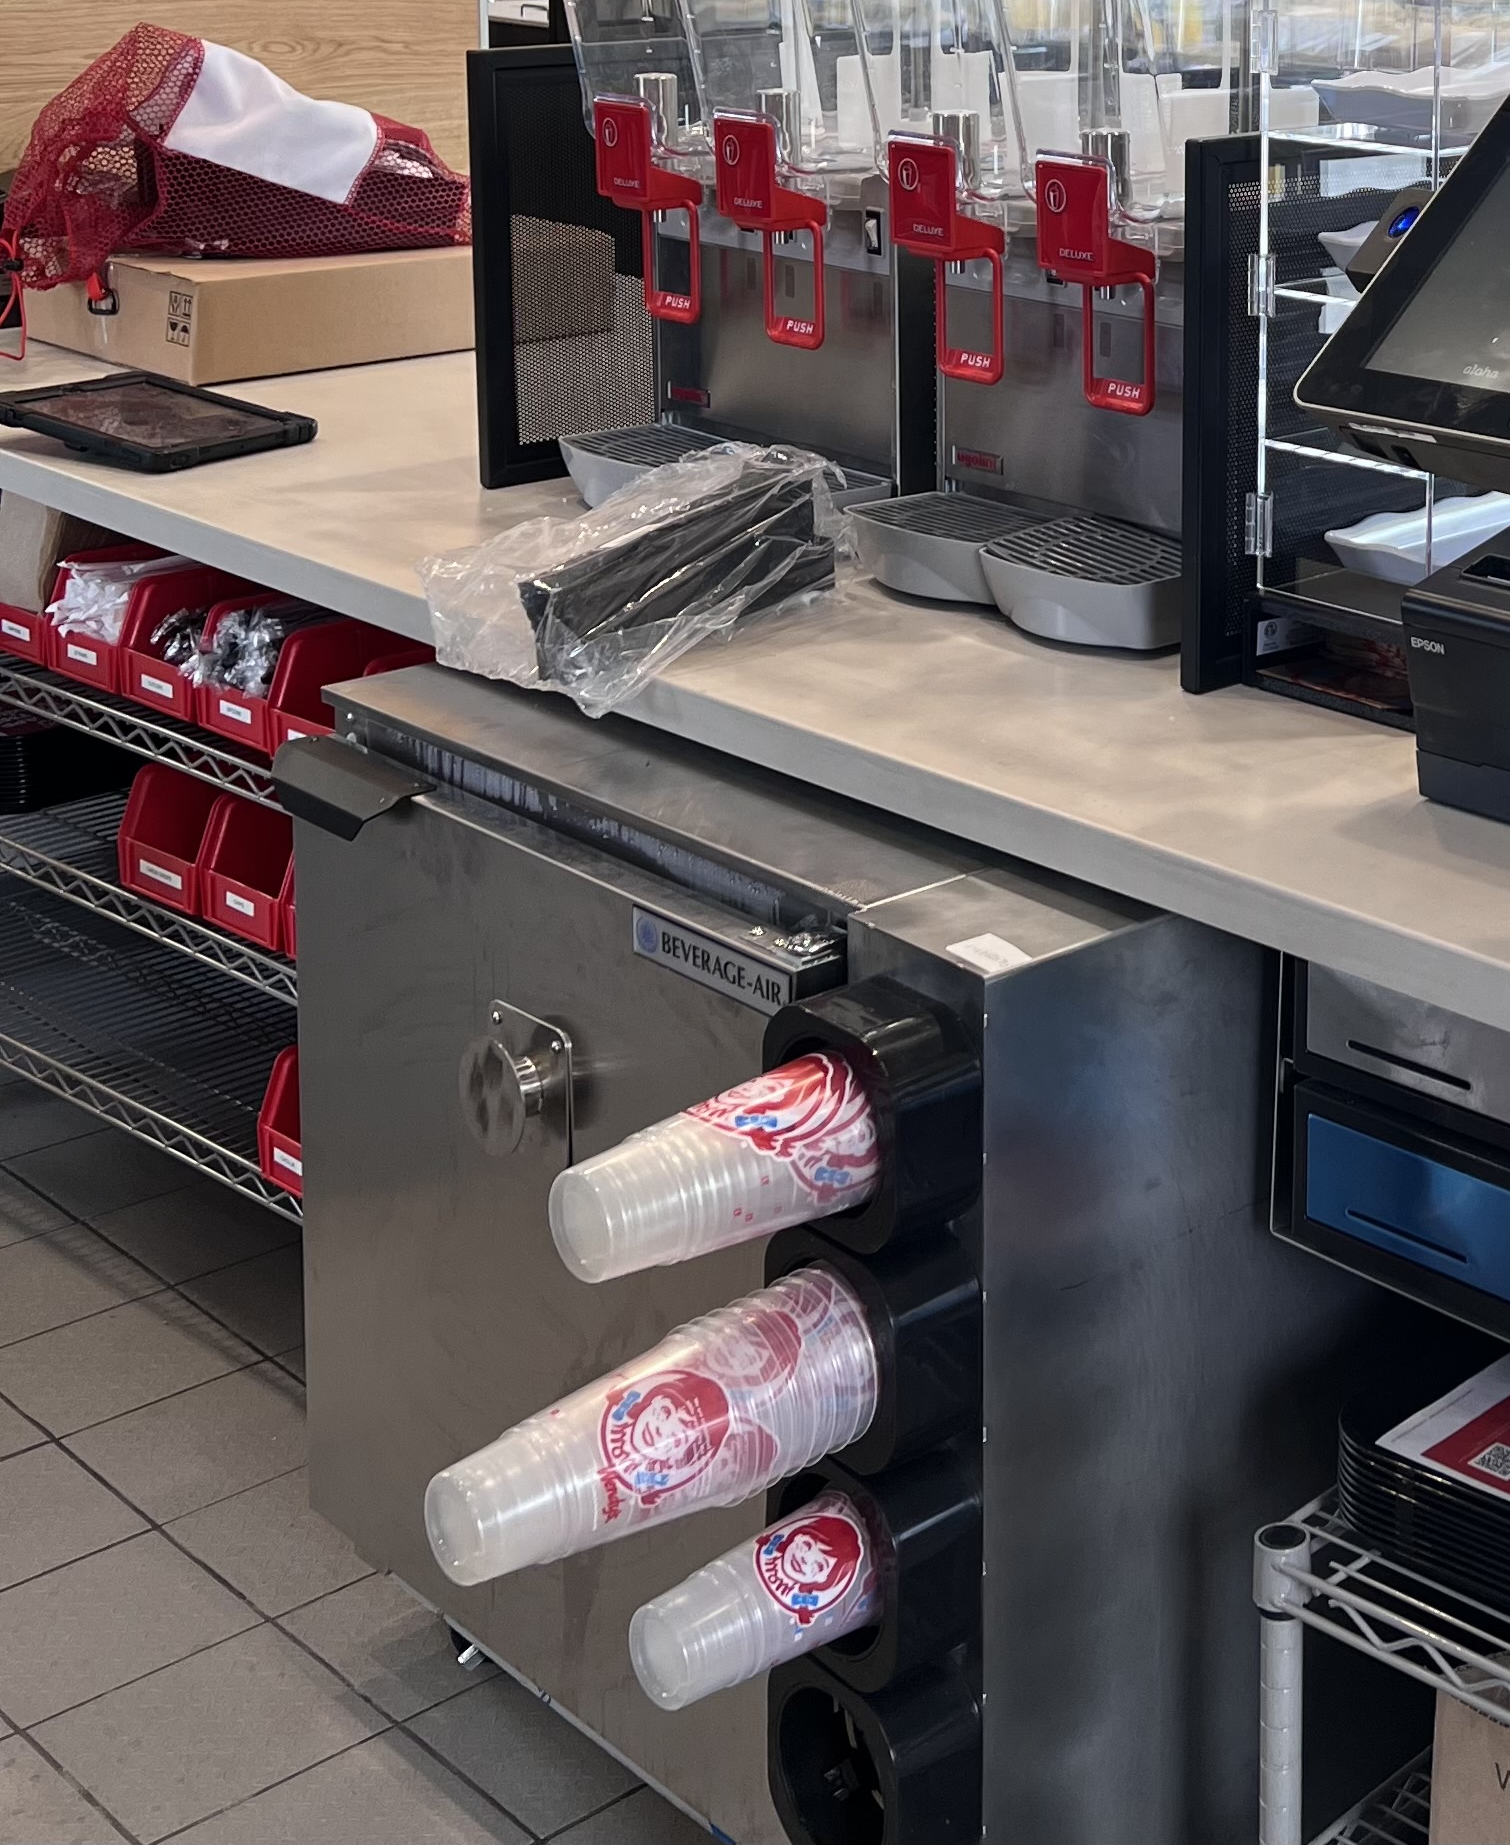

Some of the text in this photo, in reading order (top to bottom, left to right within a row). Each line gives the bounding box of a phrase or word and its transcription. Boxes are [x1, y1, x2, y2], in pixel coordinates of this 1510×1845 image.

[613, 177, 640, 189] DELUXE
[733, 197, 763, 209] DELUXE
[912, 223, 944, 237] DELUXE
[1059, 247, 1094, 262] DELUXE
[665, 296, 690, 309] PUSH
[786, 320, 814, 334] PUSH
[960, 353, 991, 368] PUSH
[1463, 364, 1499, 380] aloha
[1107, 383, 1140, 399] PUSH
[1411, 637, 1445, 655] EPSON
[661, 932, 781, 1006] BEVERAGE-AIR
